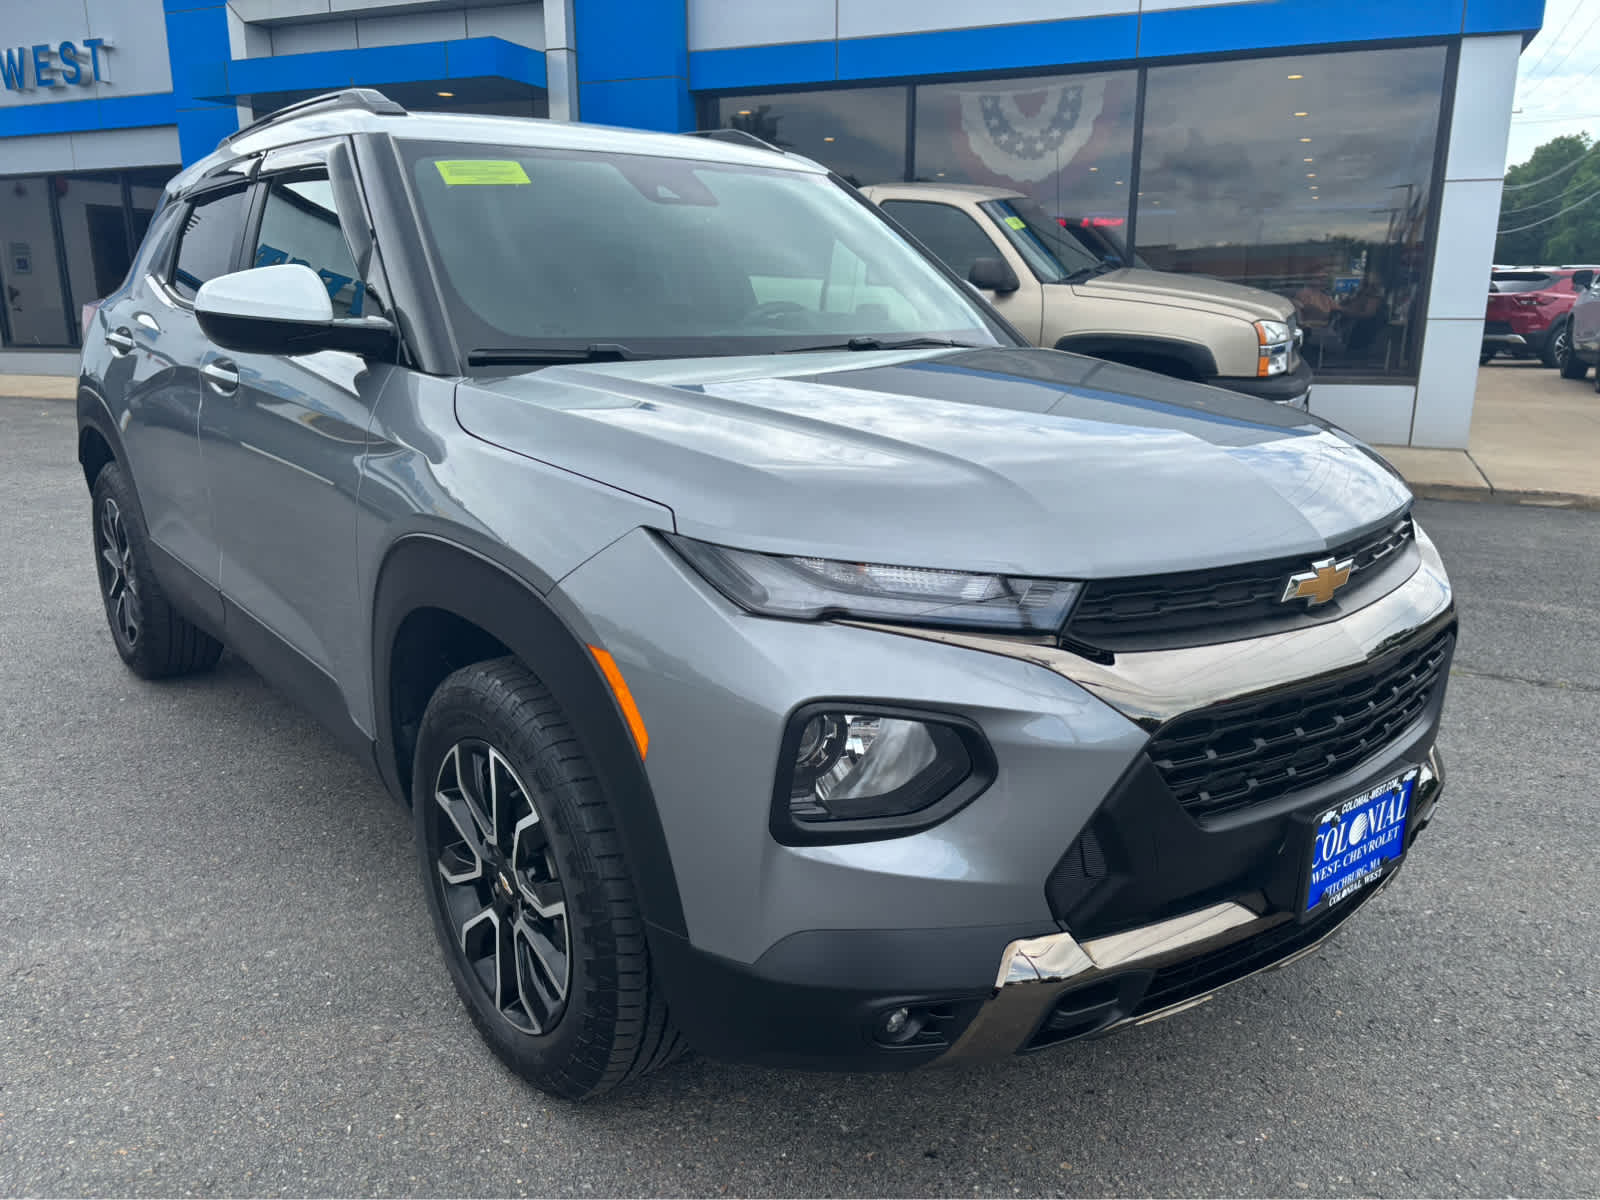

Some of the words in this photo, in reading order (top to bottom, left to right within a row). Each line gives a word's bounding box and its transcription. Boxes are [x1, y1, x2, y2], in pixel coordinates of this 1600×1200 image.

[0, 38, 104, 90] WEST
[1312, 791, 1407, 869] COLONIAL
[1343, 826, 1400, 867] CHEVROLET
[1329, 879, 1362, 907] COLONIAL
[1364, 867, 1383, 884] WEST
